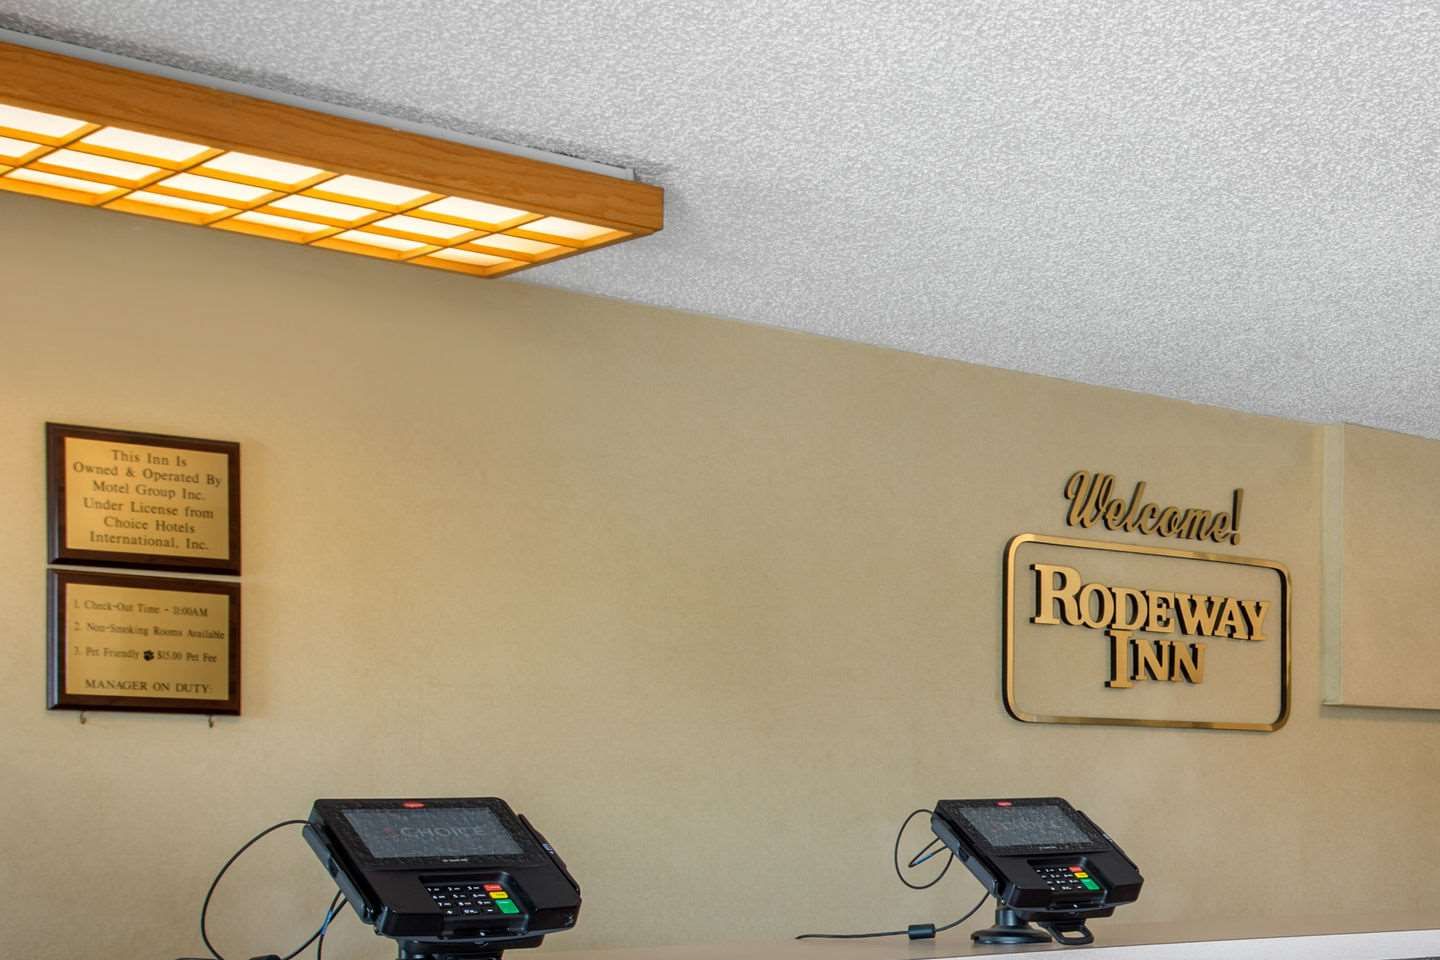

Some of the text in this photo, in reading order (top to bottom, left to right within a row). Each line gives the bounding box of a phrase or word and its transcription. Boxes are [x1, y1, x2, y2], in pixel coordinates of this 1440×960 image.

[112, 449, 188, 467] This Inn Is
[73, 461, 222, 487] Owned & Operated By
[93, 480, 206, 501] Motel Group Inc.
[83, 497, 214, 519] Under License from
[1064, 470, 1244, 545] Welcome!
[103, 516, 196, 534] Choice Hotels
[186, 538, 209, 551] Inc.
[84, 600, 133, 613] Check-Out
[138, 603, 160, 614] Time
[1031, 563, 1272, 641] RODEWAY
[87, 622, 149, 636] Non-Smoking
[153, 626, 183, 637] Rooms
[187, 628, 225, 640] Available
[103, 648, 140, 660] Friendly
[1105, 629, 1207, 689] INN
[85, 679, 148, 691] MANAGER
[153, 682, 170, 692] ON
